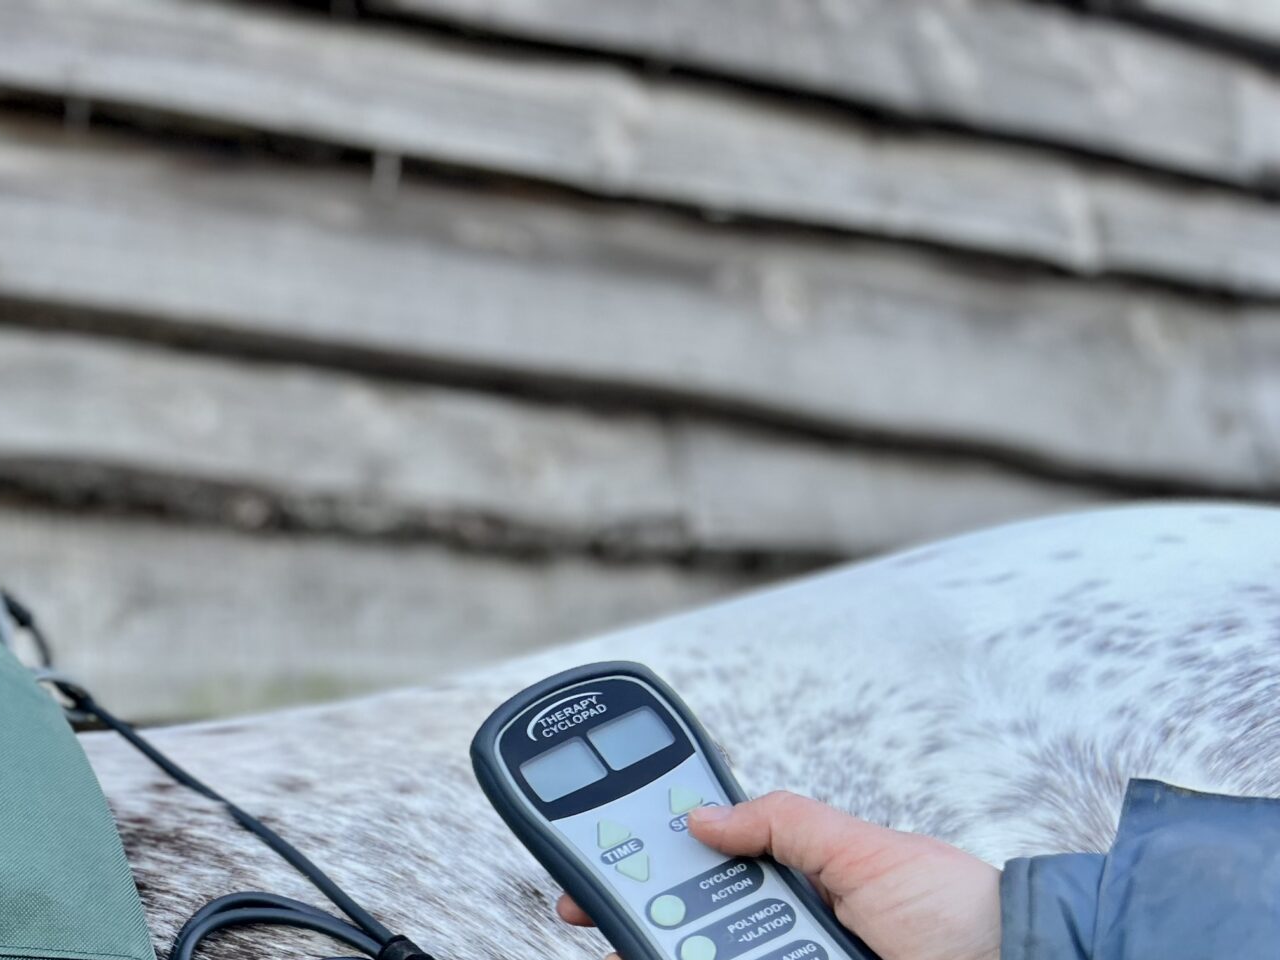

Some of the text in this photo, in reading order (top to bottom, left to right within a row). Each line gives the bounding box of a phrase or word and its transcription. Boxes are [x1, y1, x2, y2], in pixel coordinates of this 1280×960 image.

[538, 695, 597, 727] THERAPY
[542, 704, 607, 737] CYCLOPAD
[603, 841, 639, 862] TIME
[699, 863, 747, 890] CYCLOID
[711, 878, 753, 902] ACTION
[727, 903, 786, 933] POLYMOD-
[738, 914, 792, 942] -ULATION
